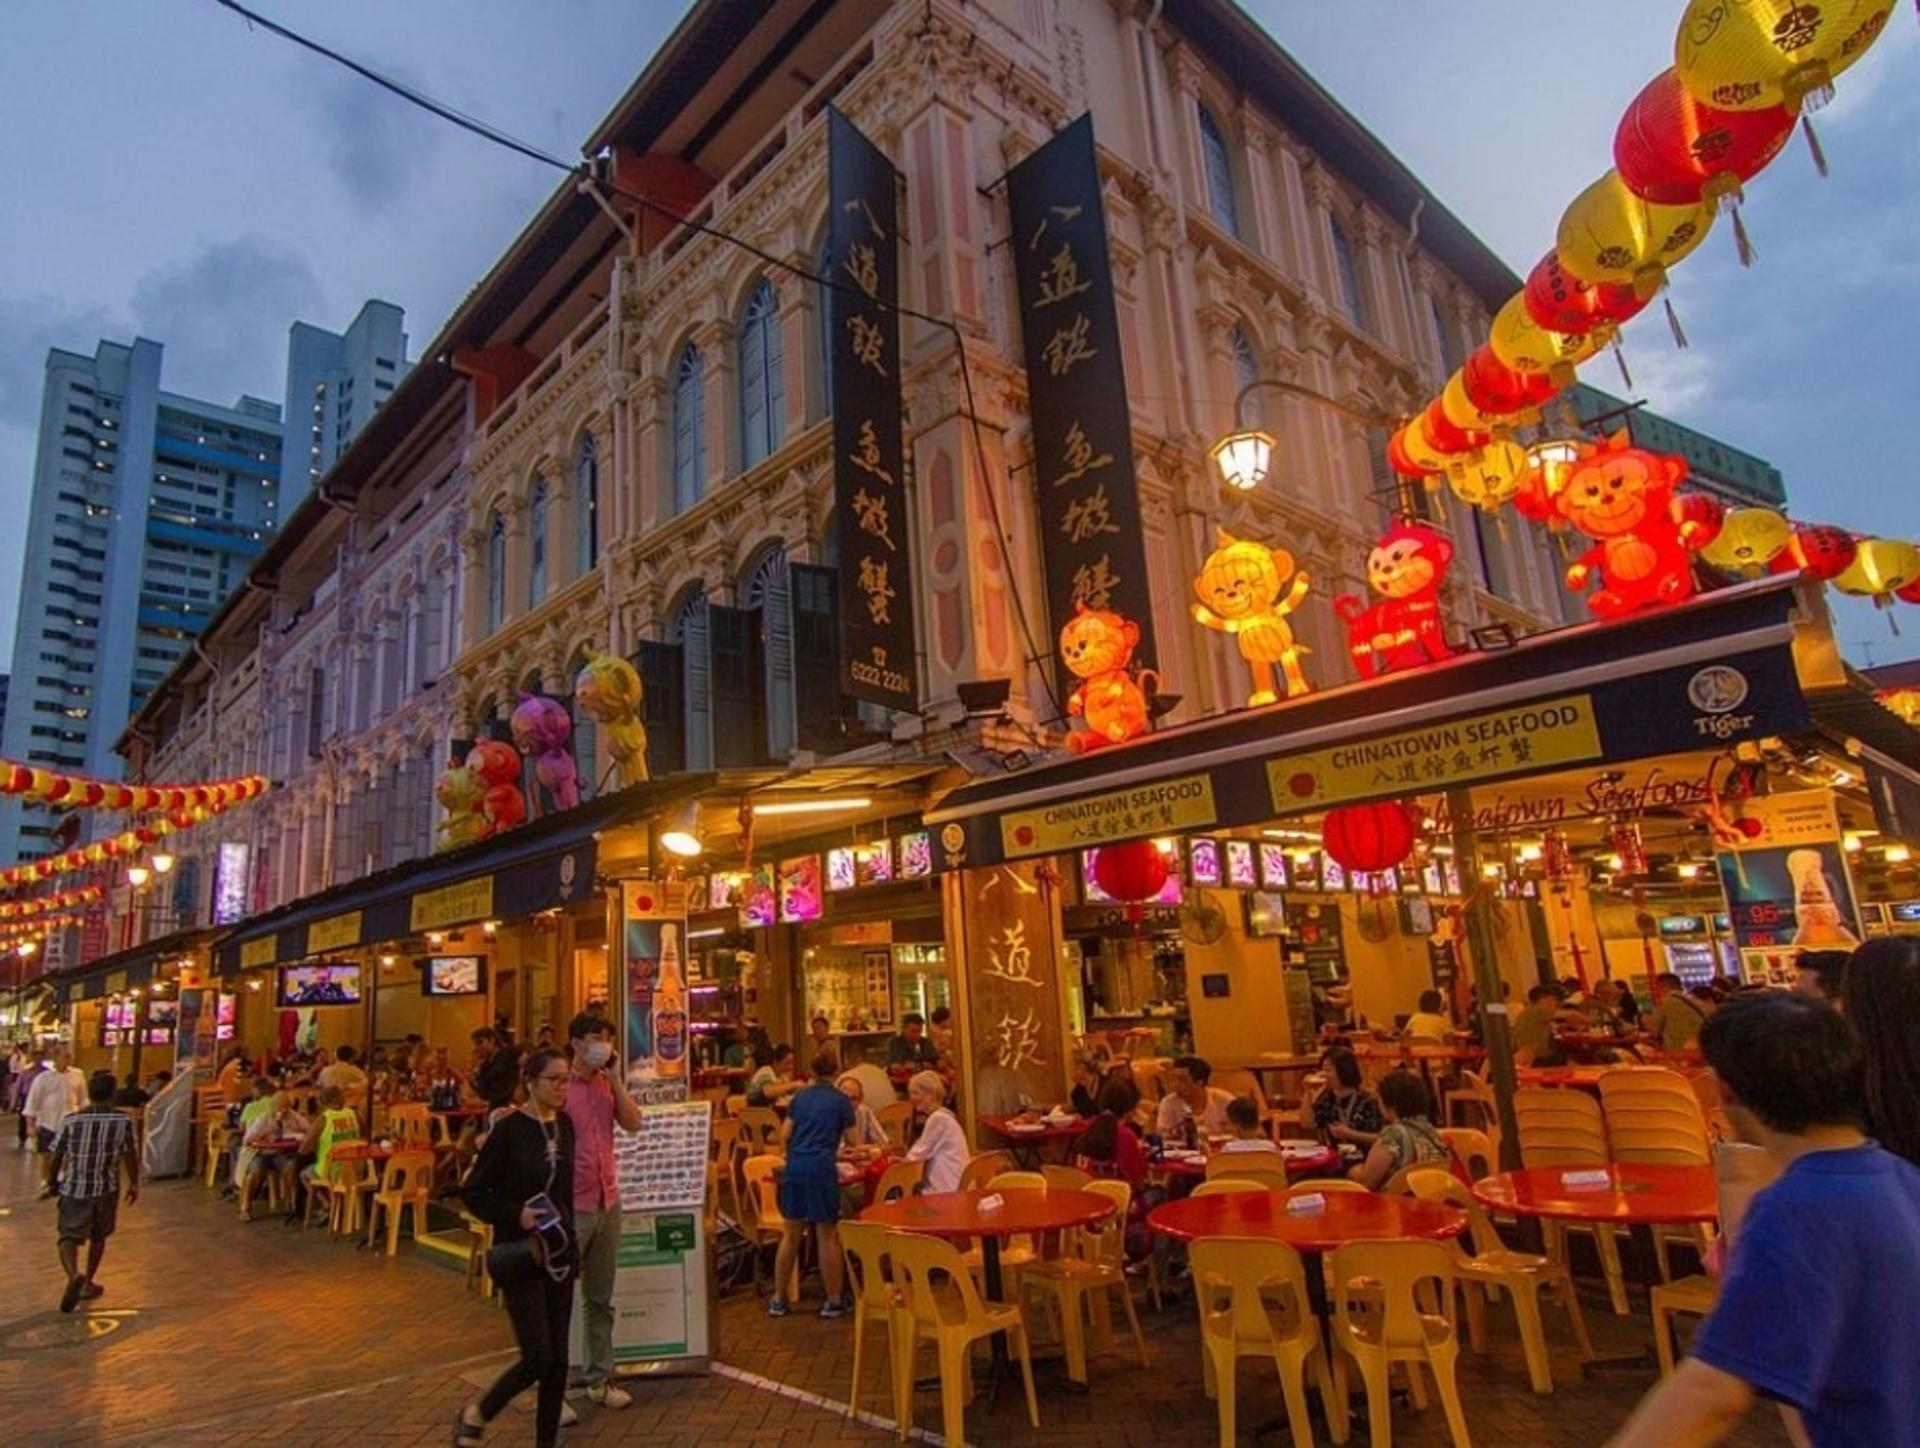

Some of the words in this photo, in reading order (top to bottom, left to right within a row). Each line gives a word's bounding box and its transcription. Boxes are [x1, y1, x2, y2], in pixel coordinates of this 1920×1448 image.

[1331, 728, 1460, 770] CHINATOWN
[1466, 704, 1579, 744] SEAFOOD
[1693, 713, 1755, 739] Tiger
[1044, 796, 1129, 826] CHINATOWN
[1131, 781, 1204, 810] SEAFOOD
[1577, 752, 1731, 817] Seafood
